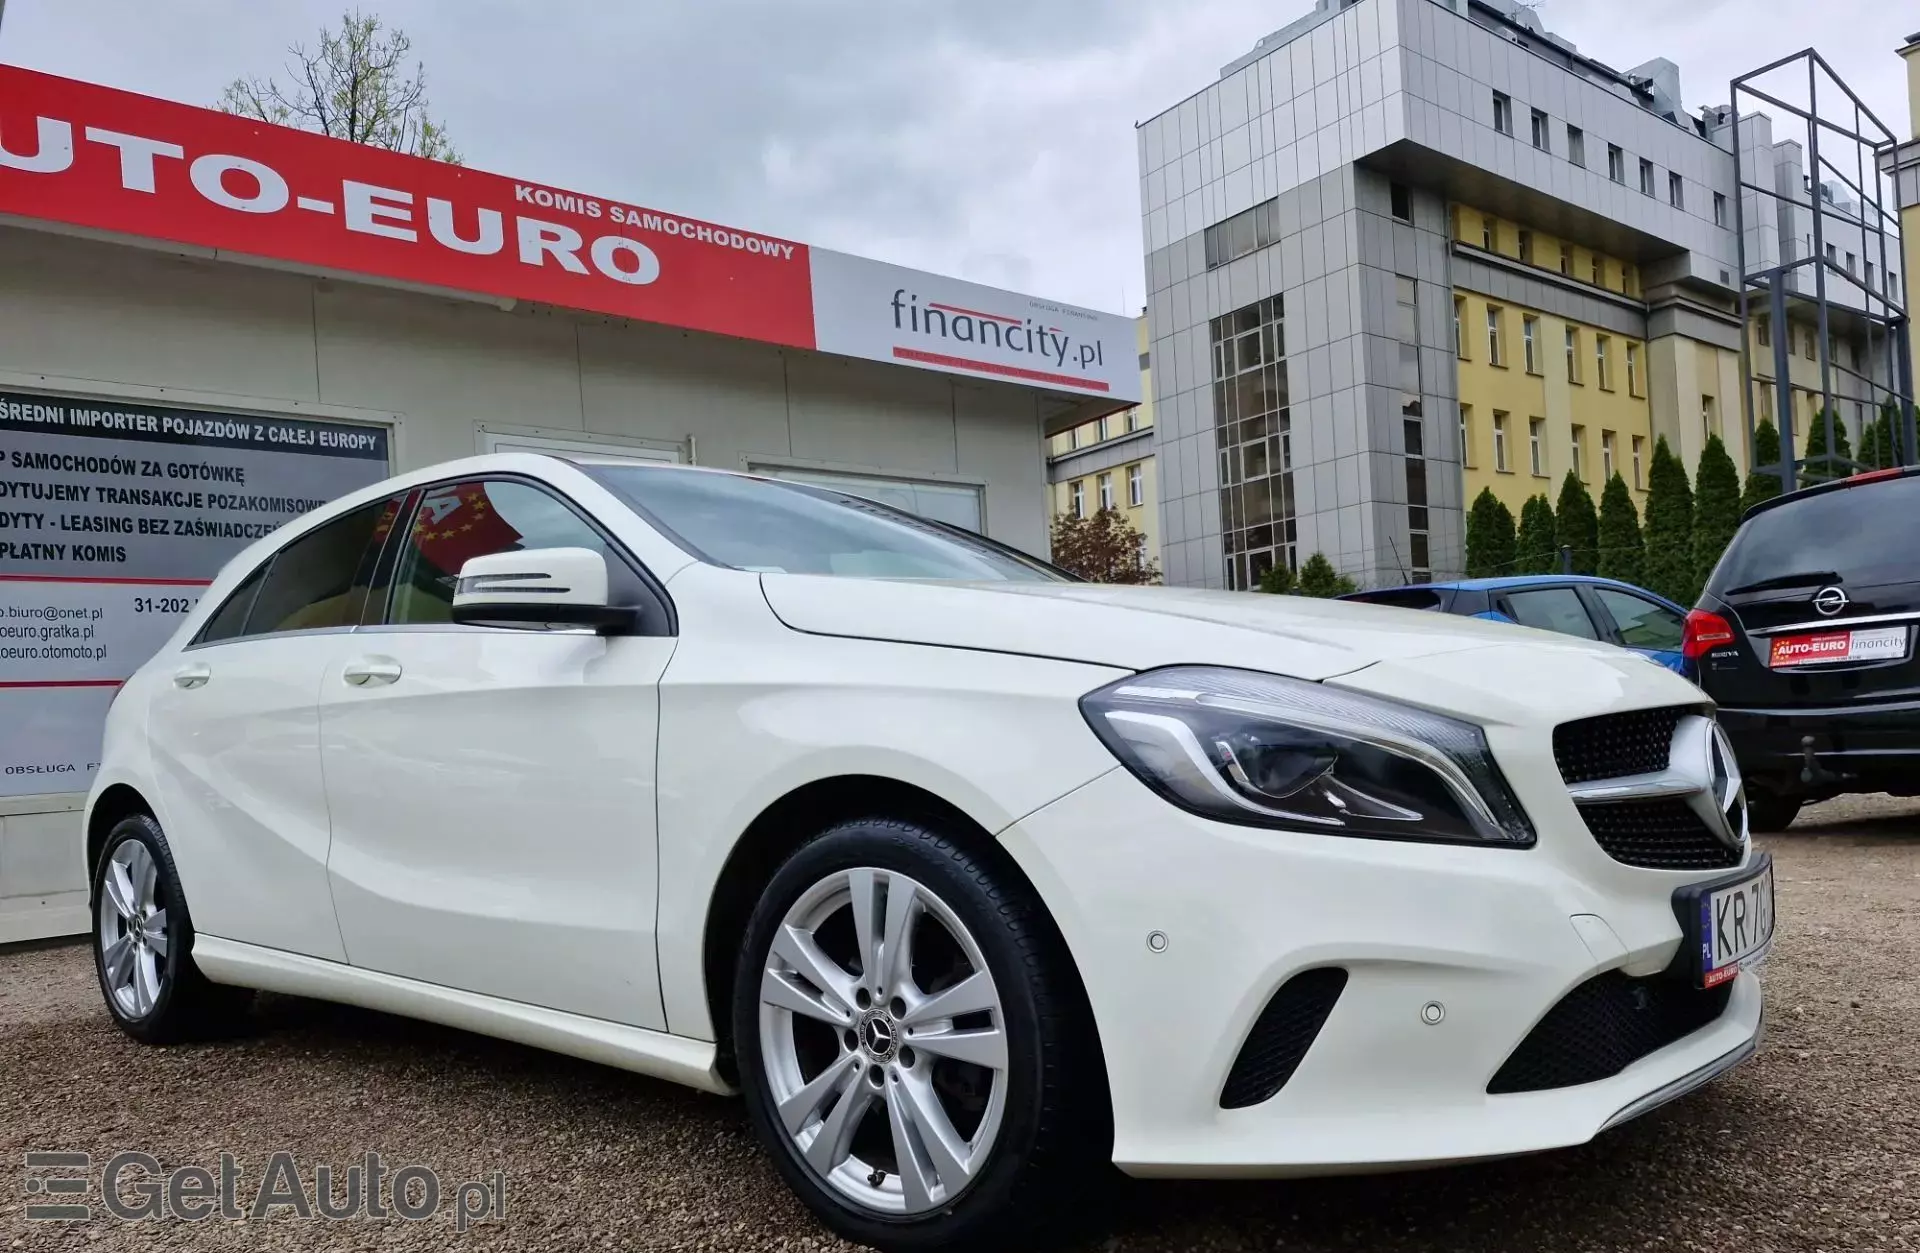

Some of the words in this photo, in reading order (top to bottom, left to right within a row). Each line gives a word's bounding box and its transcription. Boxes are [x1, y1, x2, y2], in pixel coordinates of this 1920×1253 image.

[515, 184, 602, 218] KOMIS
[610, 206, 794, 260] SAMOCHODOWY
[891, 289, 1103, 369] financity.pl
[70, 408, 158, 432] IMPORTER
[163, 416, 250, 441] POJAZDÓW
[254, 425, 265, 441] Z
[268, 429, 315, 446] CAŁEJ
[319, 431, 377, 450] EUROPY
[11, 450, 139, 477] SAMOCHODÓW
[141, 461, 163, 477] ZA
[167, 461, 245, 487] GOTÓWKĘ
[96, 486, 203, 509] TRANSAKCJE
[60, 515, 133, 534] LEASING
[138, 518, 168, 535] BEZ
[173, 519, 282, 540] ZAŚWIADCZE
[0, 541, 66, 560] PŁATNY
[72, 545, 126, 562] KOMIS
[134, 597, 189, 613] 31-202
[0, 644, 107, 661] oeuro.otomoto.pl
[1778, 640, 1846, 655] AUTO-EURO
[1851, 636, 1905, 649] financity
[5, 764, 76, 775] OBSŁUGA
[1716, 891, 1747, 961] KR
[1702, 943, 1711, 959] PL
